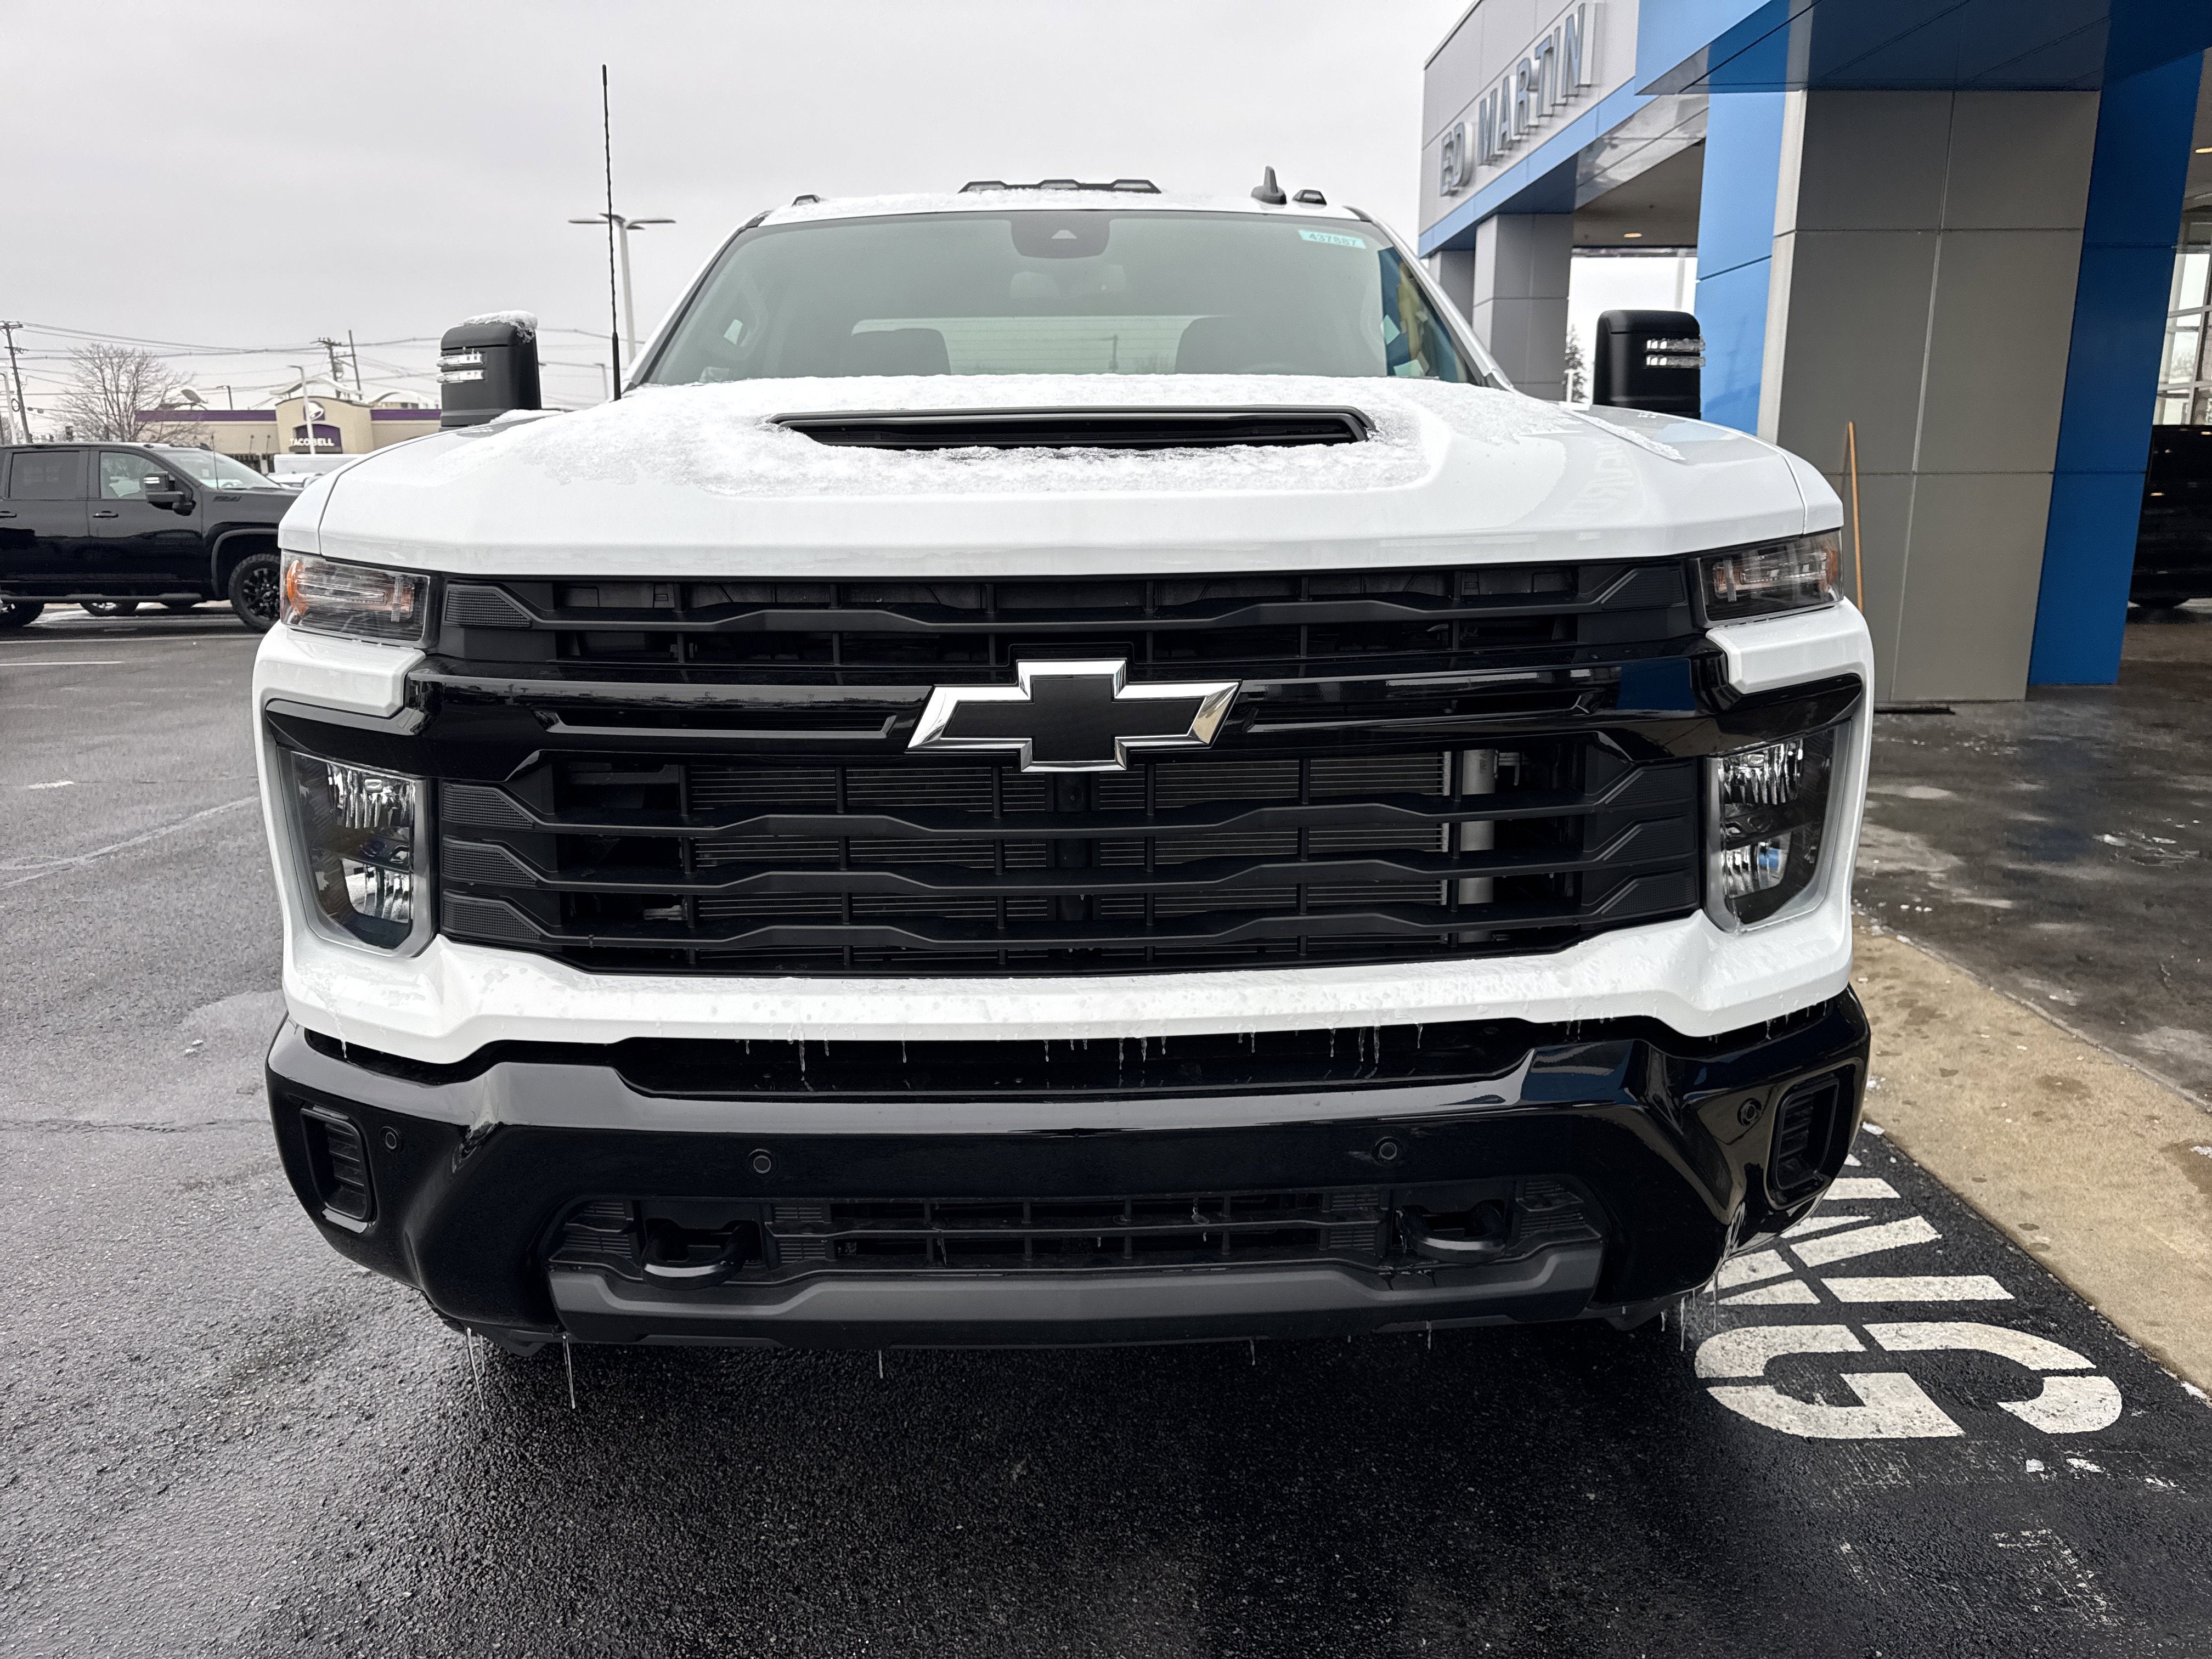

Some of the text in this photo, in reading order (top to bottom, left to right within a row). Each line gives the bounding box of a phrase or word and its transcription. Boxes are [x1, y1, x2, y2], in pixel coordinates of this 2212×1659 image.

[1440, 2, 1589, 196] ED MARTIN
[289, 438, 311, 447] TACO
